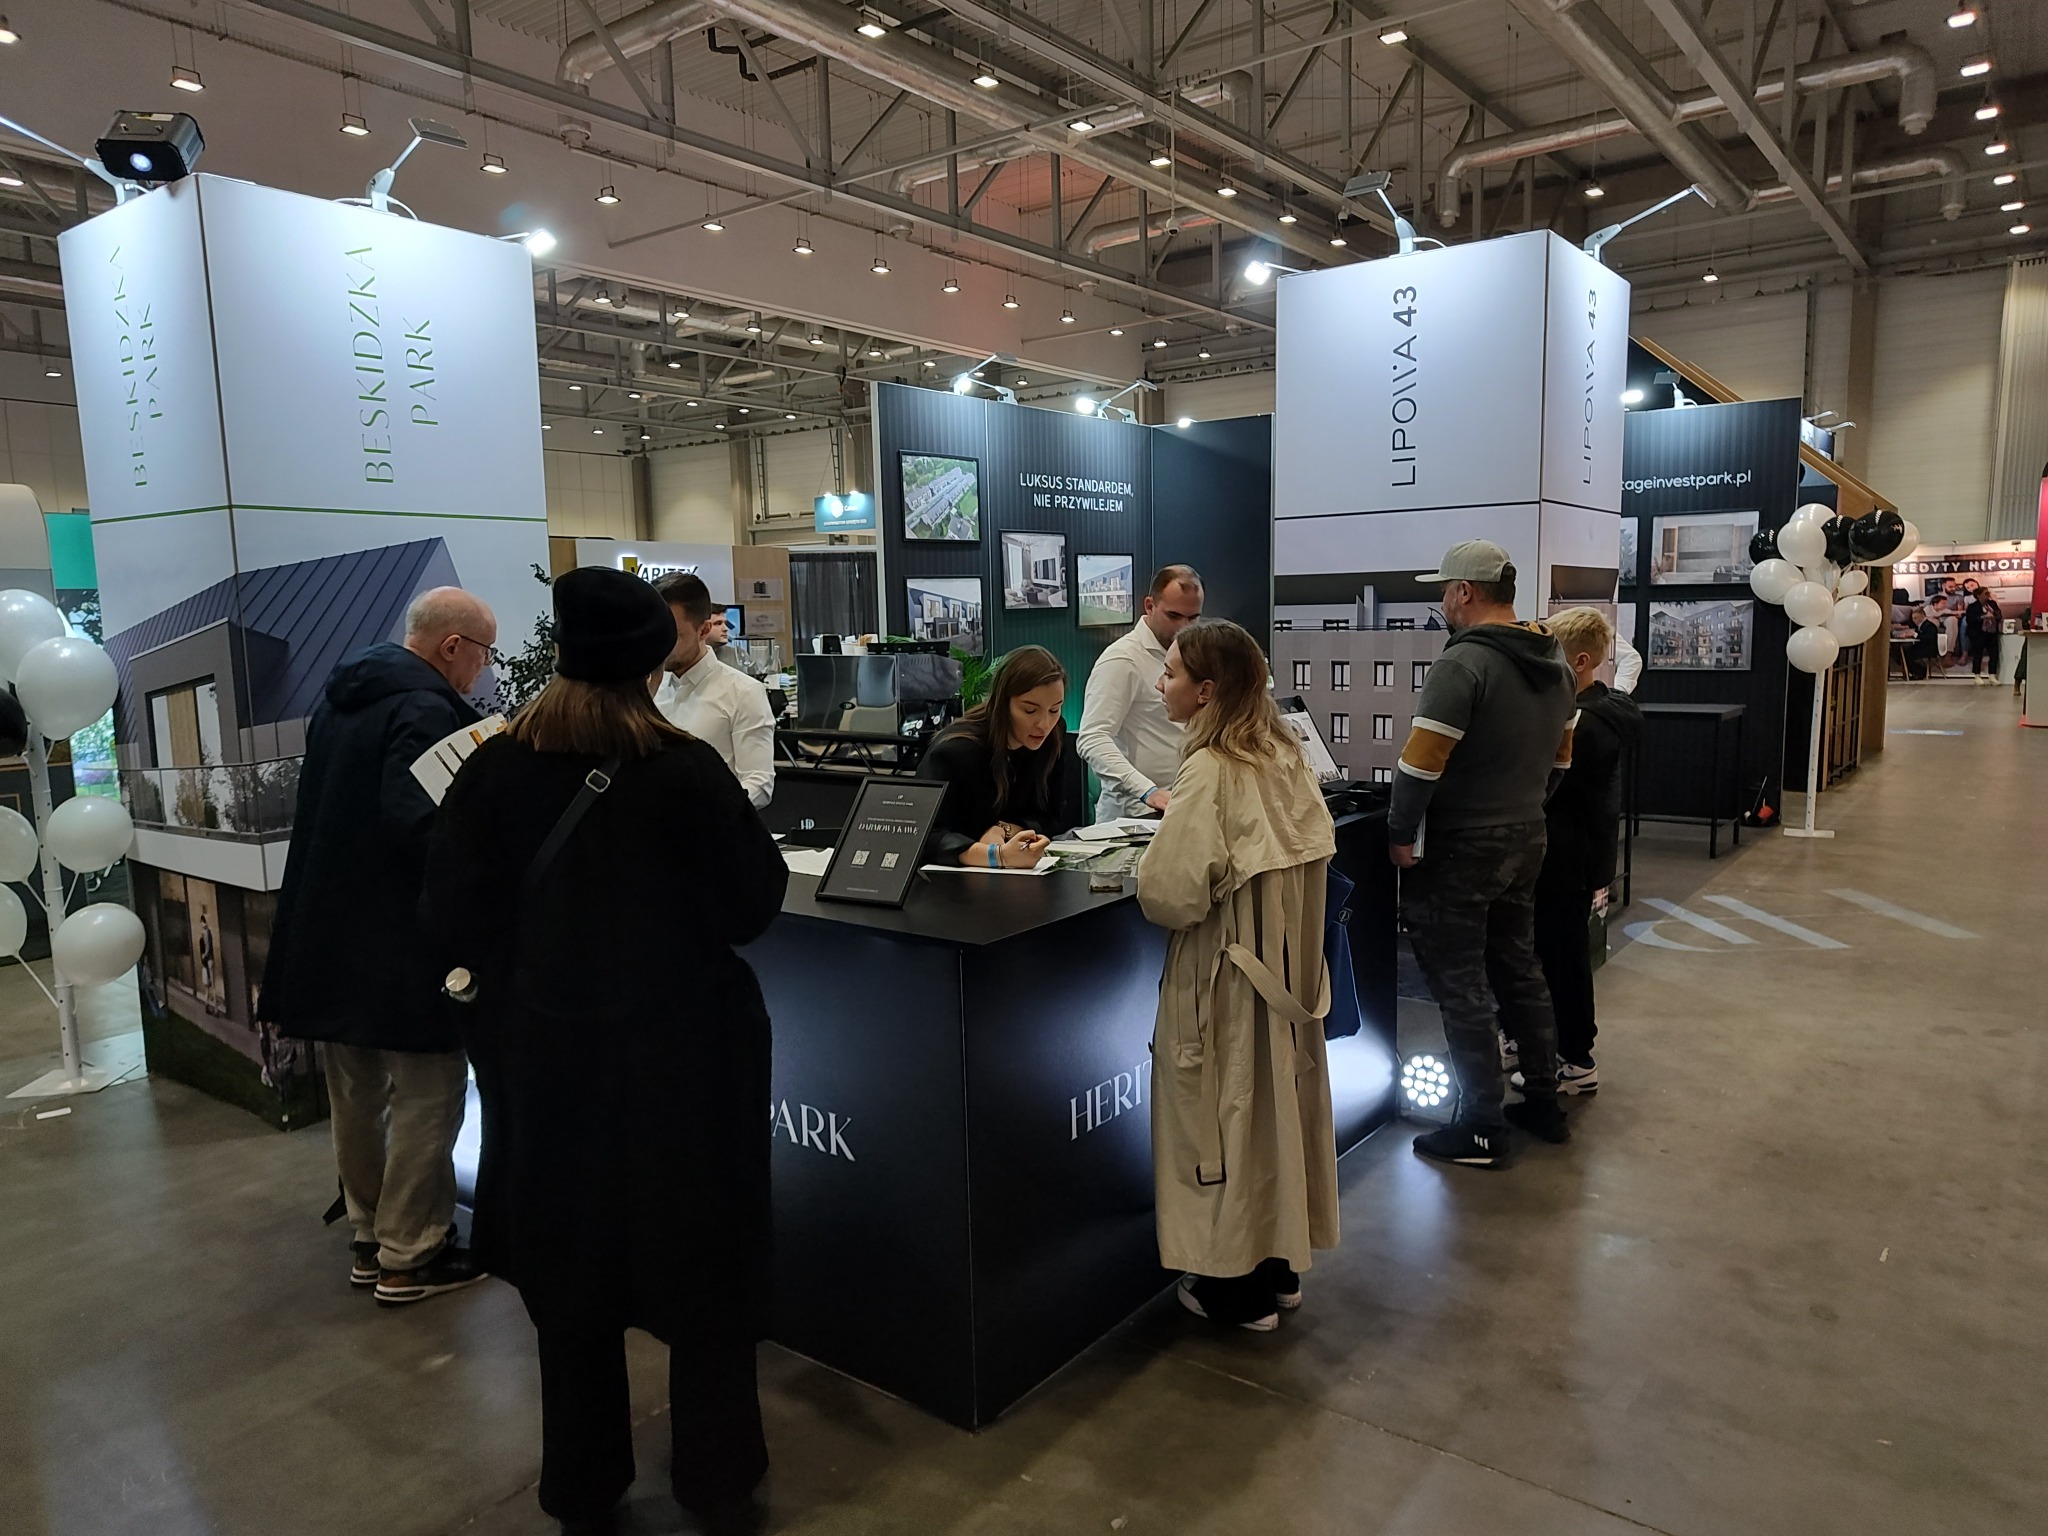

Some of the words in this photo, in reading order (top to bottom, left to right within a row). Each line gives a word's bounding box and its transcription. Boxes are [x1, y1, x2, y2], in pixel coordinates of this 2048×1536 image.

[1393, 286, 1418, 328] 43
[1588, 289, 1597, 330] 43
[109, 245, 147, 487] BESKIDZKA
[138, 302, 163, 419] PARK
[344, 247, 394, 483] BESKIDZKA
[402, 316, 439, 425] PARK
[1020, 472, 1063, 490] LUKSUS
[1065, 476, 1134, 498] STANDARDEM,
[1033, 493, 1051, 507] NIE
[1054, 494, 1124, 512] PRZYWILEJEM
[770, 1098, 856, 1162] ARK
